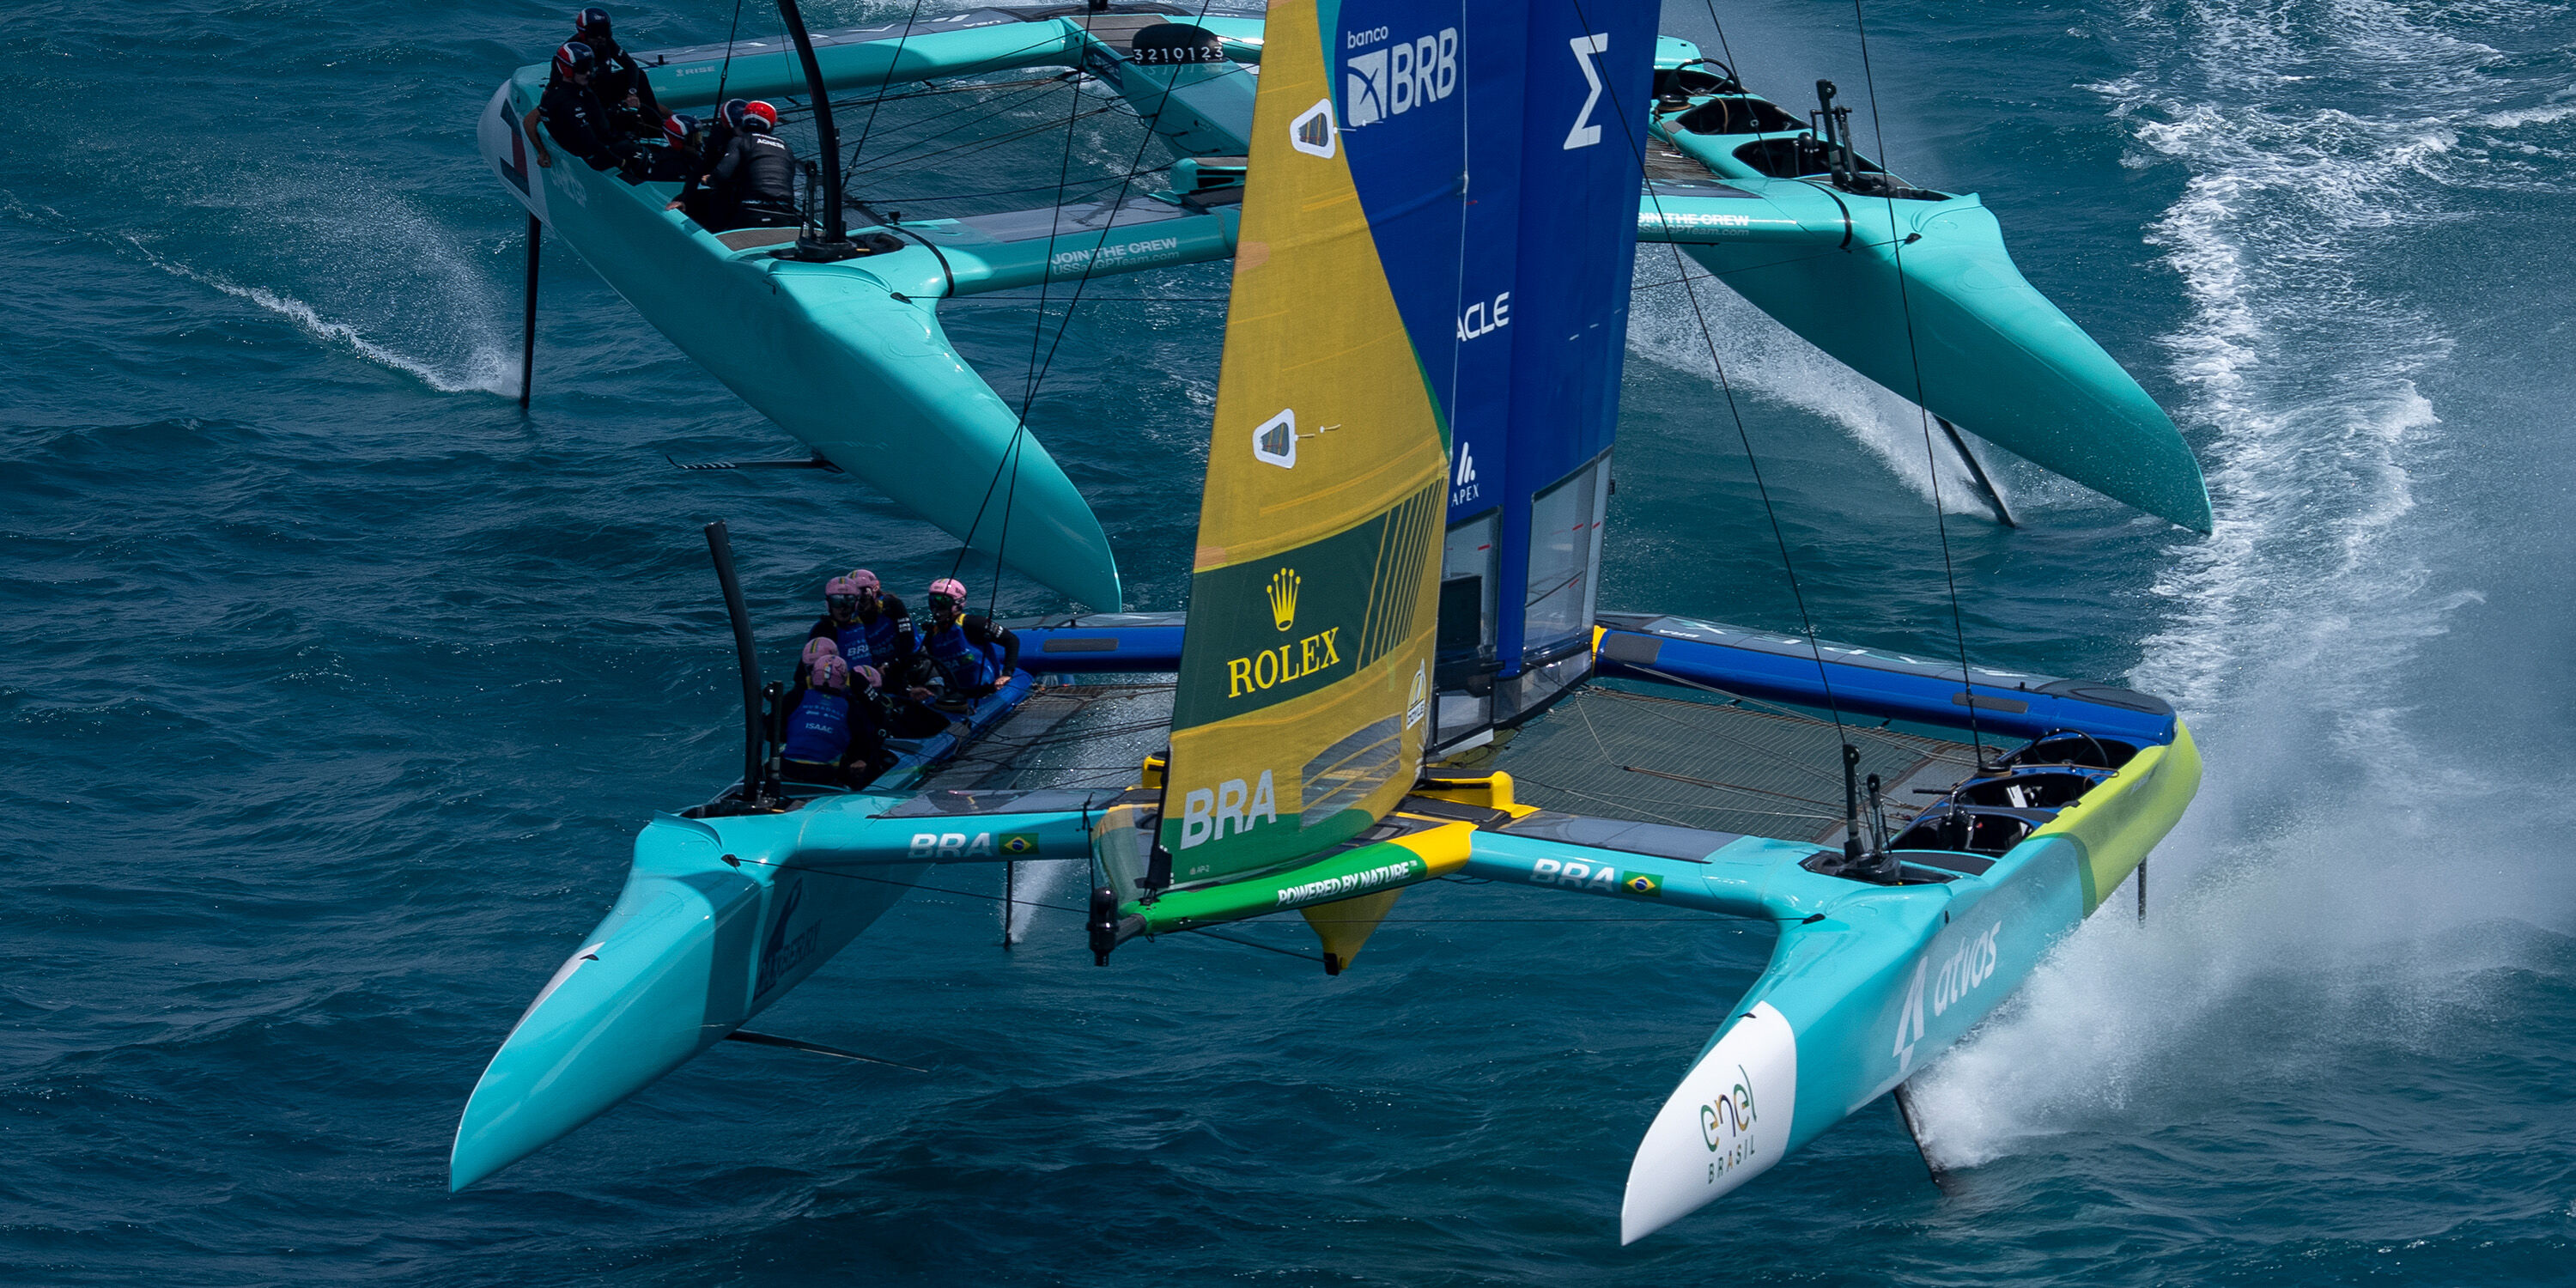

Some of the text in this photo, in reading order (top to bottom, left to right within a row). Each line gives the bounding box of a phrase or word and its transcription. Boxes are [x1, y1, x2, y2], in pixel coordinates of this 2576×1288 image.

[1347, 26, 1388, 49] banco
[684, 65, 715, 76] RISE
[1390, 27, 1458, 115] BRB
[1663, 212, 1699, 225] THE
[1700, 214, 1750, 226] CREW
[1051, 236, 1178, 265] JOIN THE CREW
[1451, 483, 1479, 507] APEX
[1227, 627, 1340, 699] ROLEX
[1180, 769, 1278, 850] BRA
[907, 832, 993, 859] BRA
[1276, 878, 1342, 907] POWERED
[1340, 872, 1359, 894] BY
[1529, 858, 1615, 892] BRA
[1934, 920, 2002, 1018] atvos
[1700, 1064, 1758, 1152] enel
[1708, 1134, 1756, 1185] BRASIL
